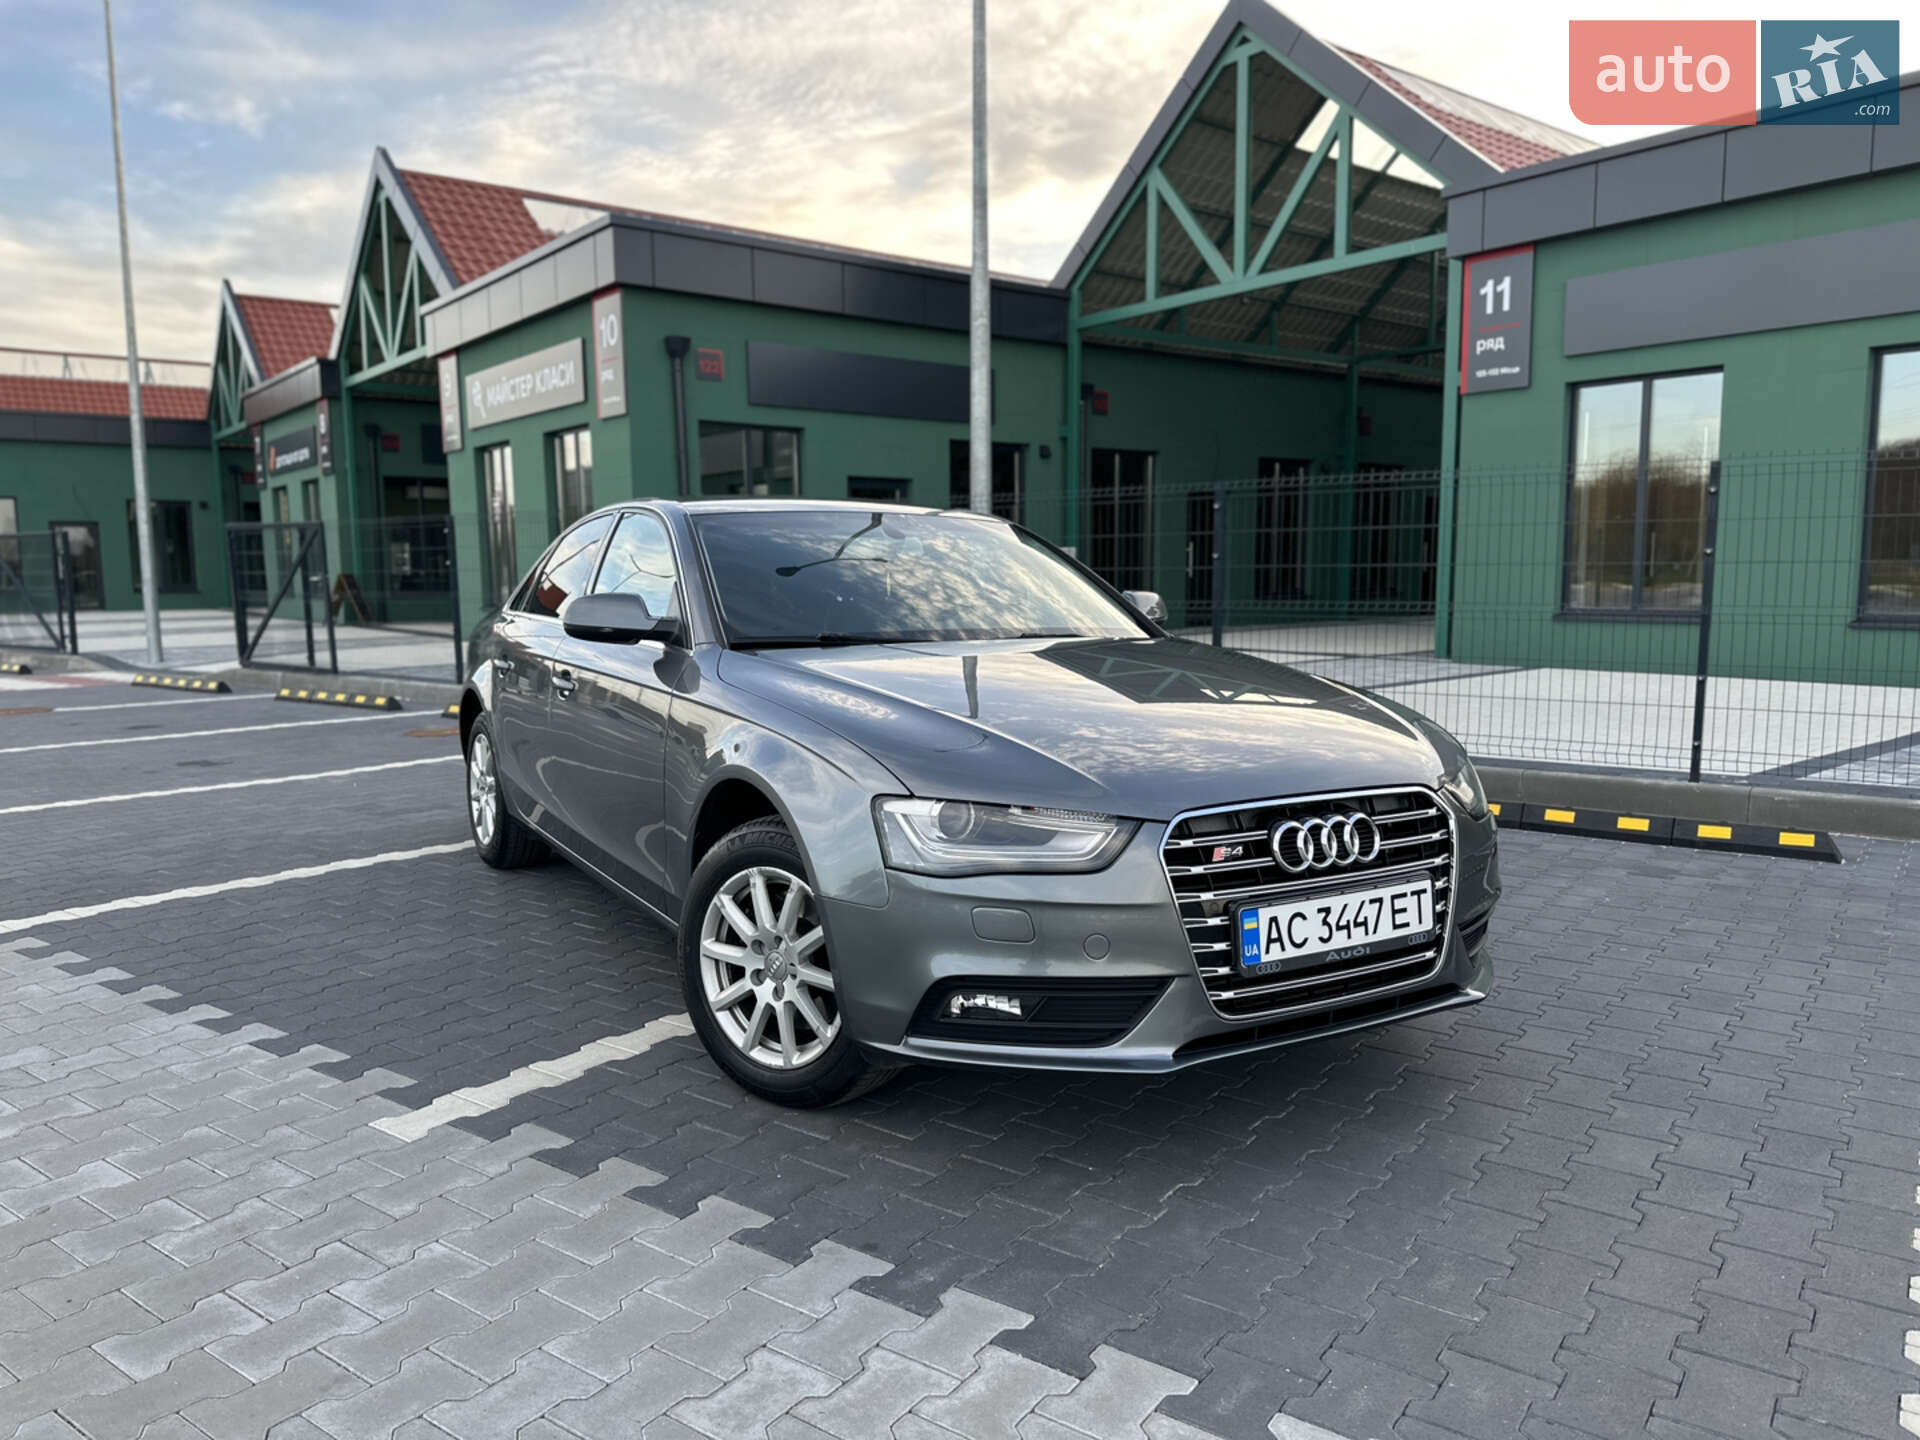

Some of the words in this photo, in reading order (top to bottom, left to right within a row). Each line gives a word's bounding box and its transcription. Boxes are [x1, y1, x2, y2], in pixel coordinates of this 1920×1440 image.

[1480, 275, 1512, 315] 11
[600, 313, 618, 348] 10
[1264, 911, 1309, 955] AC
[1317, 896, 1384, 944] 3447
[1391, 888, 1428, 930] ET
[1244, 943, 1260, 957] UA
